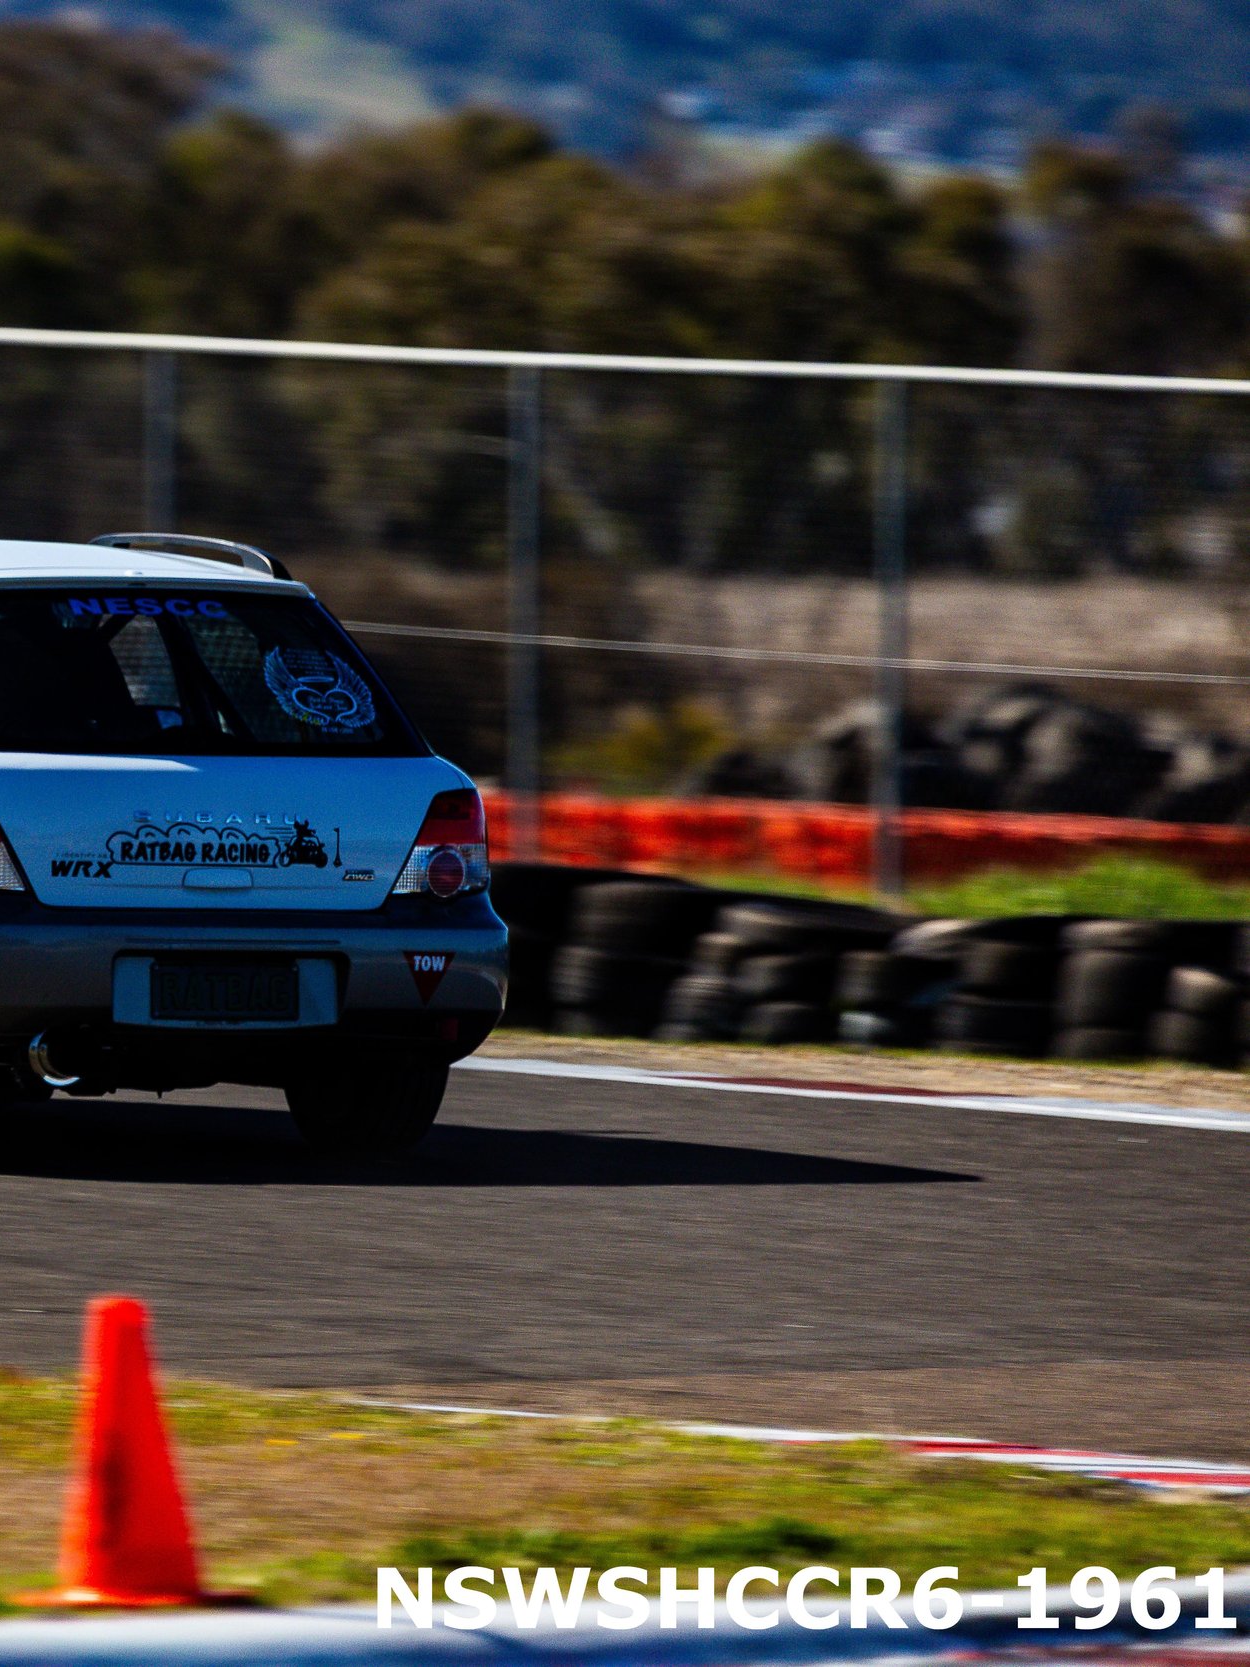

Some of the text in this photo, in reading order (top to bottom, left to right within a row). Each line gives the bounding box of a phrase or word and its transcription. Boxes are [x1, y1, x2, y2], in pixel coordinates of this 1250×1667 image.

[68, 598, 228, 618] NESCC
[133, 810, 301, 824] SUBARU
[121, 841, 271, 863] RATBAG RACING
[51, 860, 113, 878] WRX
[413, 955, 446, 971] TOW
[160, 972, 289, 1010] RATBAG
